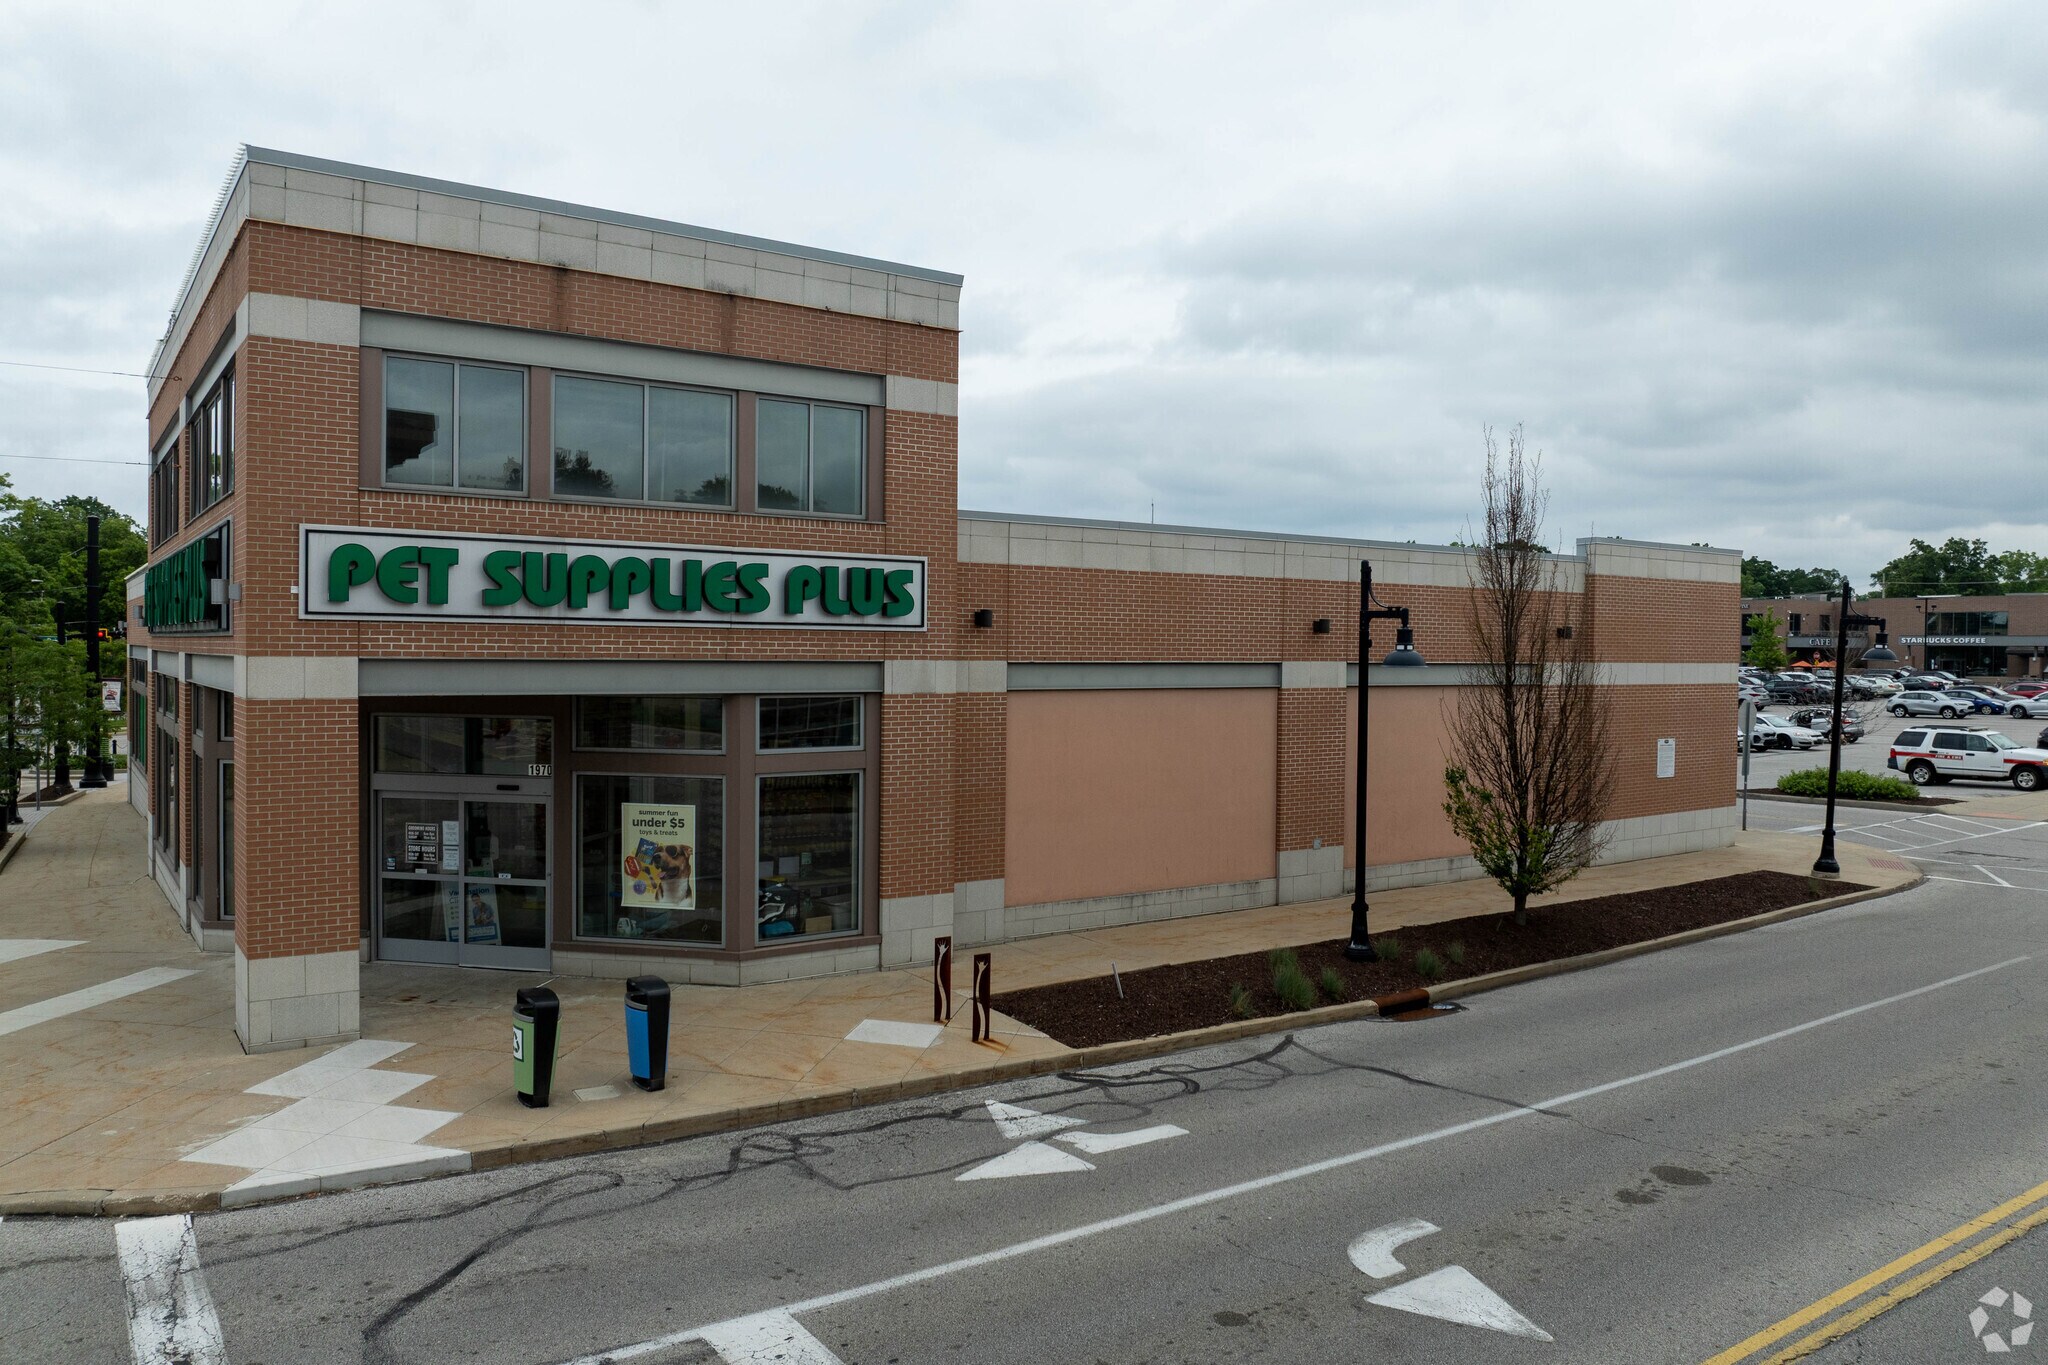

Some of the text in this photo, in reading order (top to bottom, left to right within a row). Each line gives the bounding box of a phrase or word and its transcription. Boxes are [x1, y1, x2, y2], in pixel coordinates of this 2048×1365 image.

[328, 543, 914, 618] PET SUPPLIES PLUS
[529, 764, 552, 776] 1970
[632, 817, 685, 829] under $5
